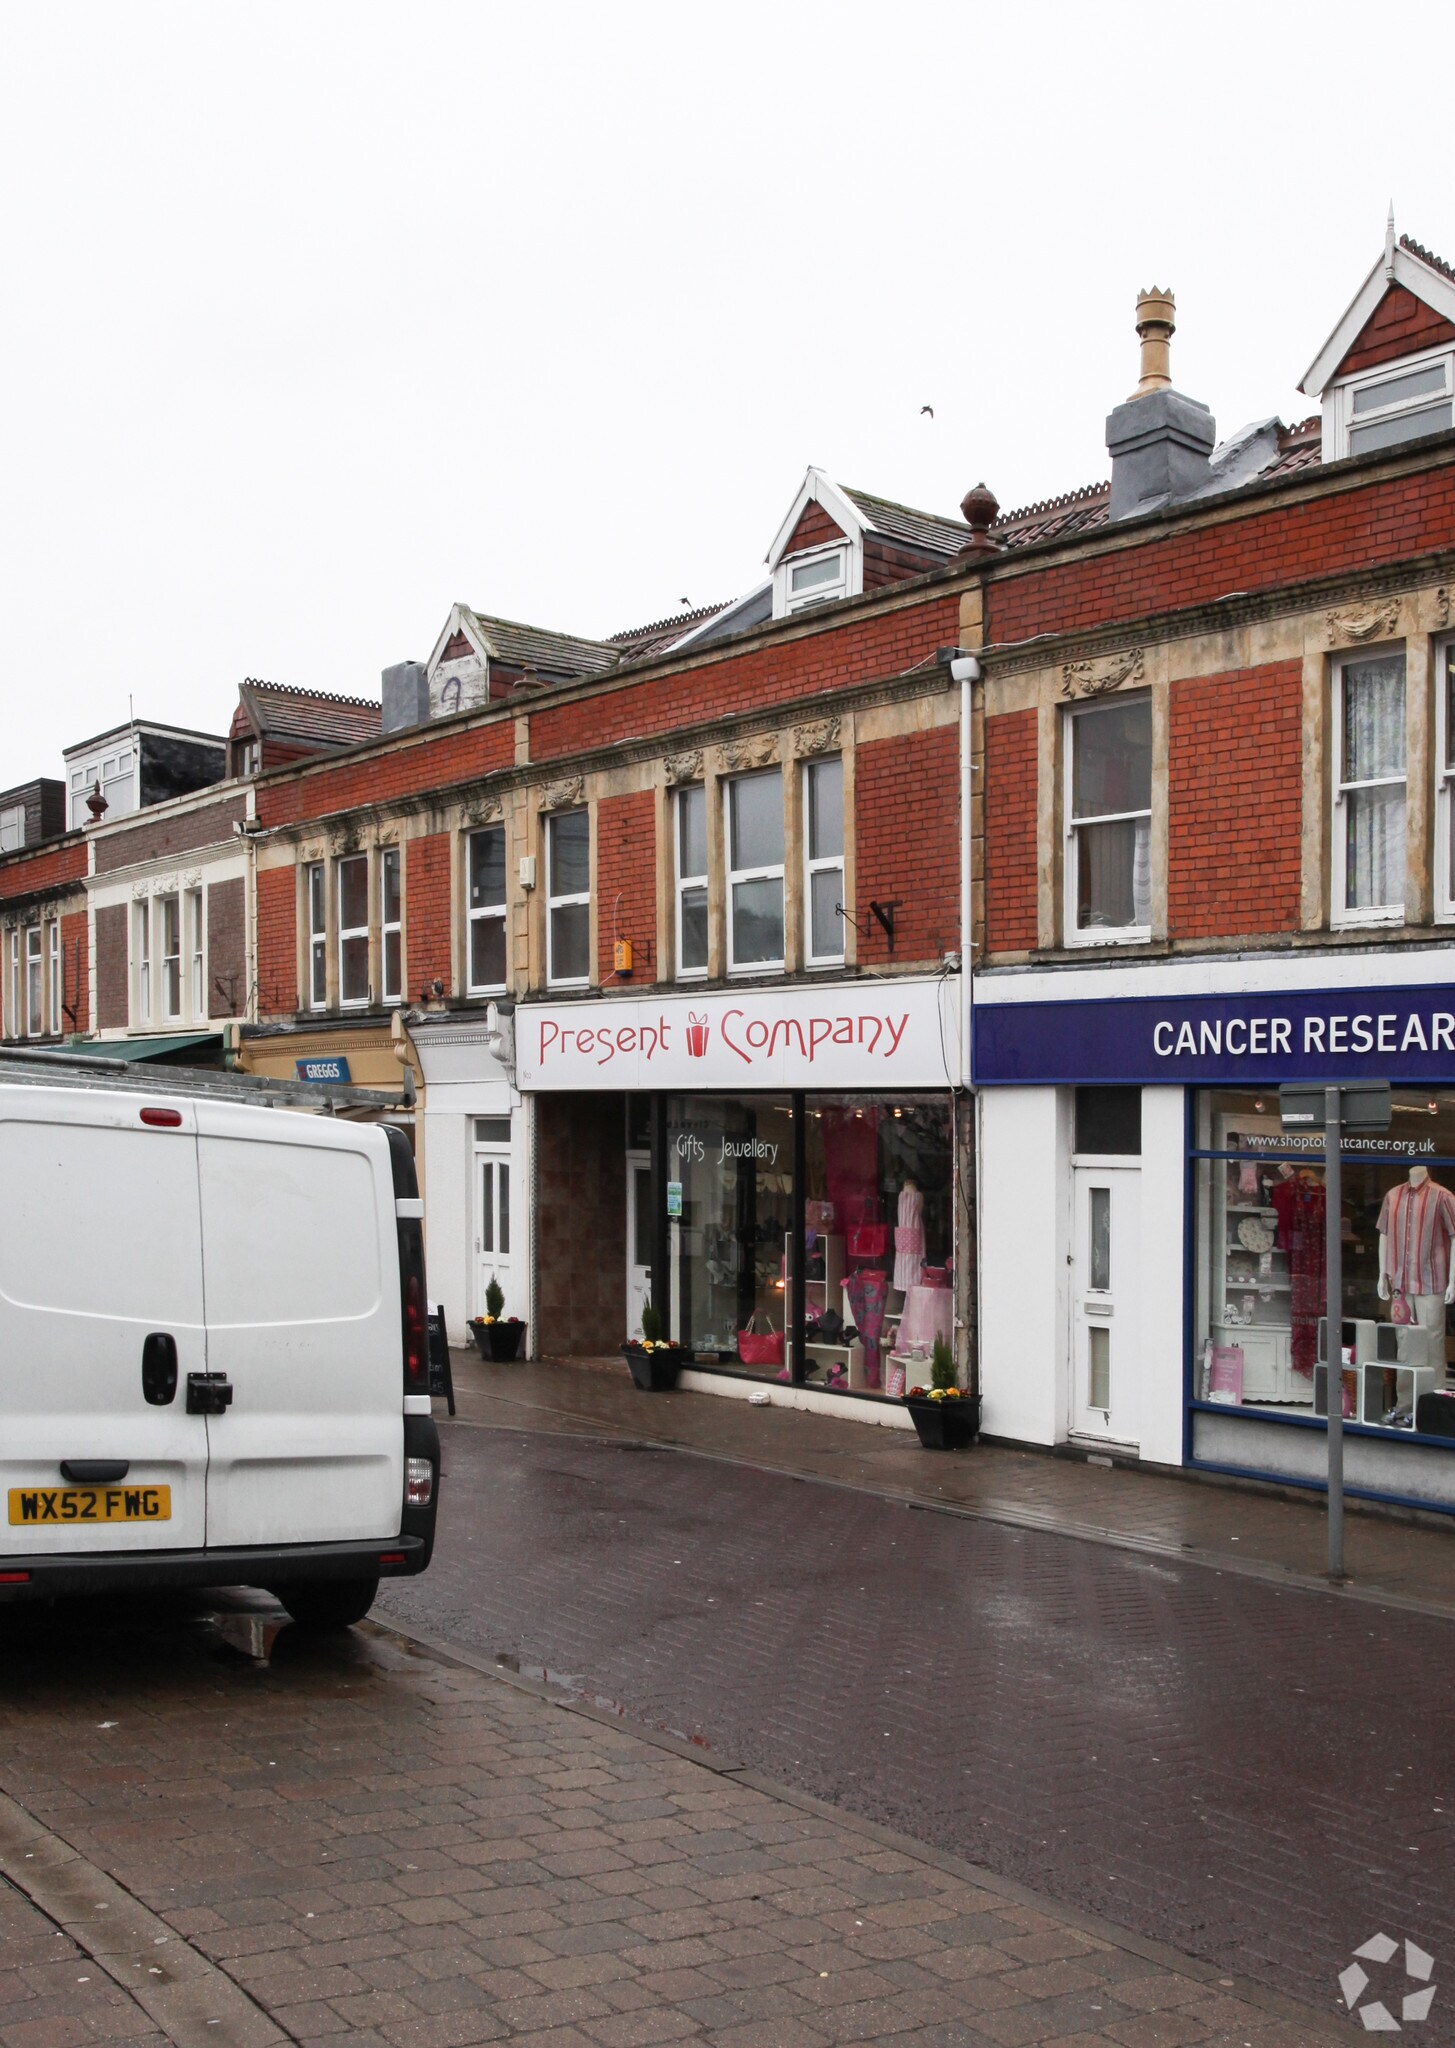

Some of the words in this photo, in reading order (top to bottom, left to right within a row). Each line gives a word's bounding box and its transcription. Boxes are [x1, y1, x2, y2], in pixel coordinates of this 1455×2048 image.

[540, 1014, 671, 1066] Present
[720, 1009, 910, 1064] Company
[1153, 1018, 1292, 1056] CANCER
[1304, 1012, 1455, 1053] RESEAR
[306, 1062, 340, 1079] GREGGS
[676, 1134, 705, 1163] Gifts
[717, 1136, 779, 1165] Jewellery
[1247, 1134, 1436, 1156] www.shoptoatcancer.org.uk
[21, 1492, 98, 1520] WX52
[106, 1489, 160, 1518] FWG
